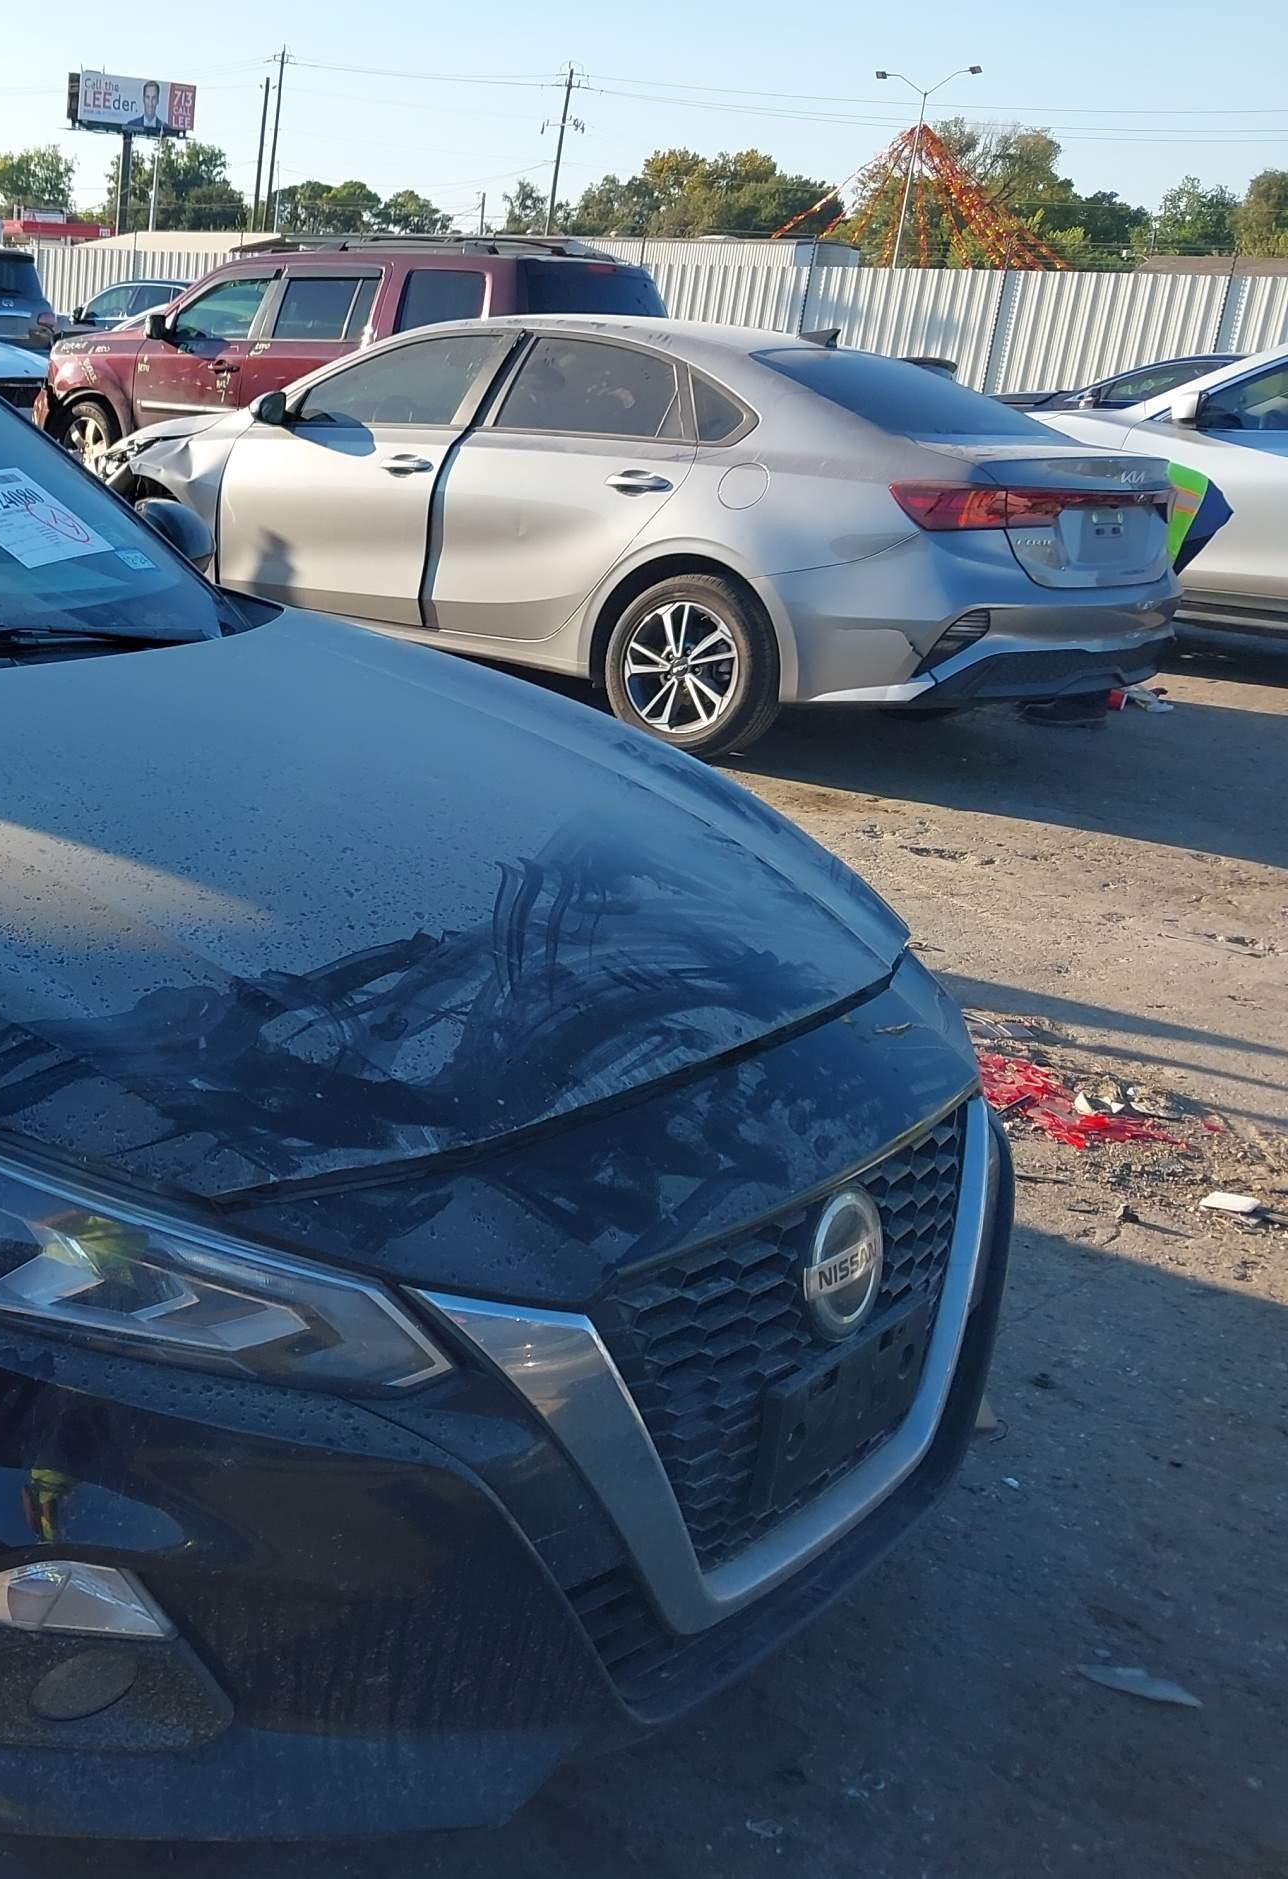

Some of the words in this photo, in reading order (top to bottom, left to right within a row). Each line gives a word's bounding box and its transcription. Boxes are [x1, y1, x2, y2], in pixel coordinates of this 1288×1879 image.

[84, 78, 102, 90] Call
[104, 80, 119, 93] the
[174, 90, 193, 107] 713
[172, 105, 192, 117] CALL
[172, 115, 192, 129] LEE
[818, 1238, 877, 1290] NISSAN
